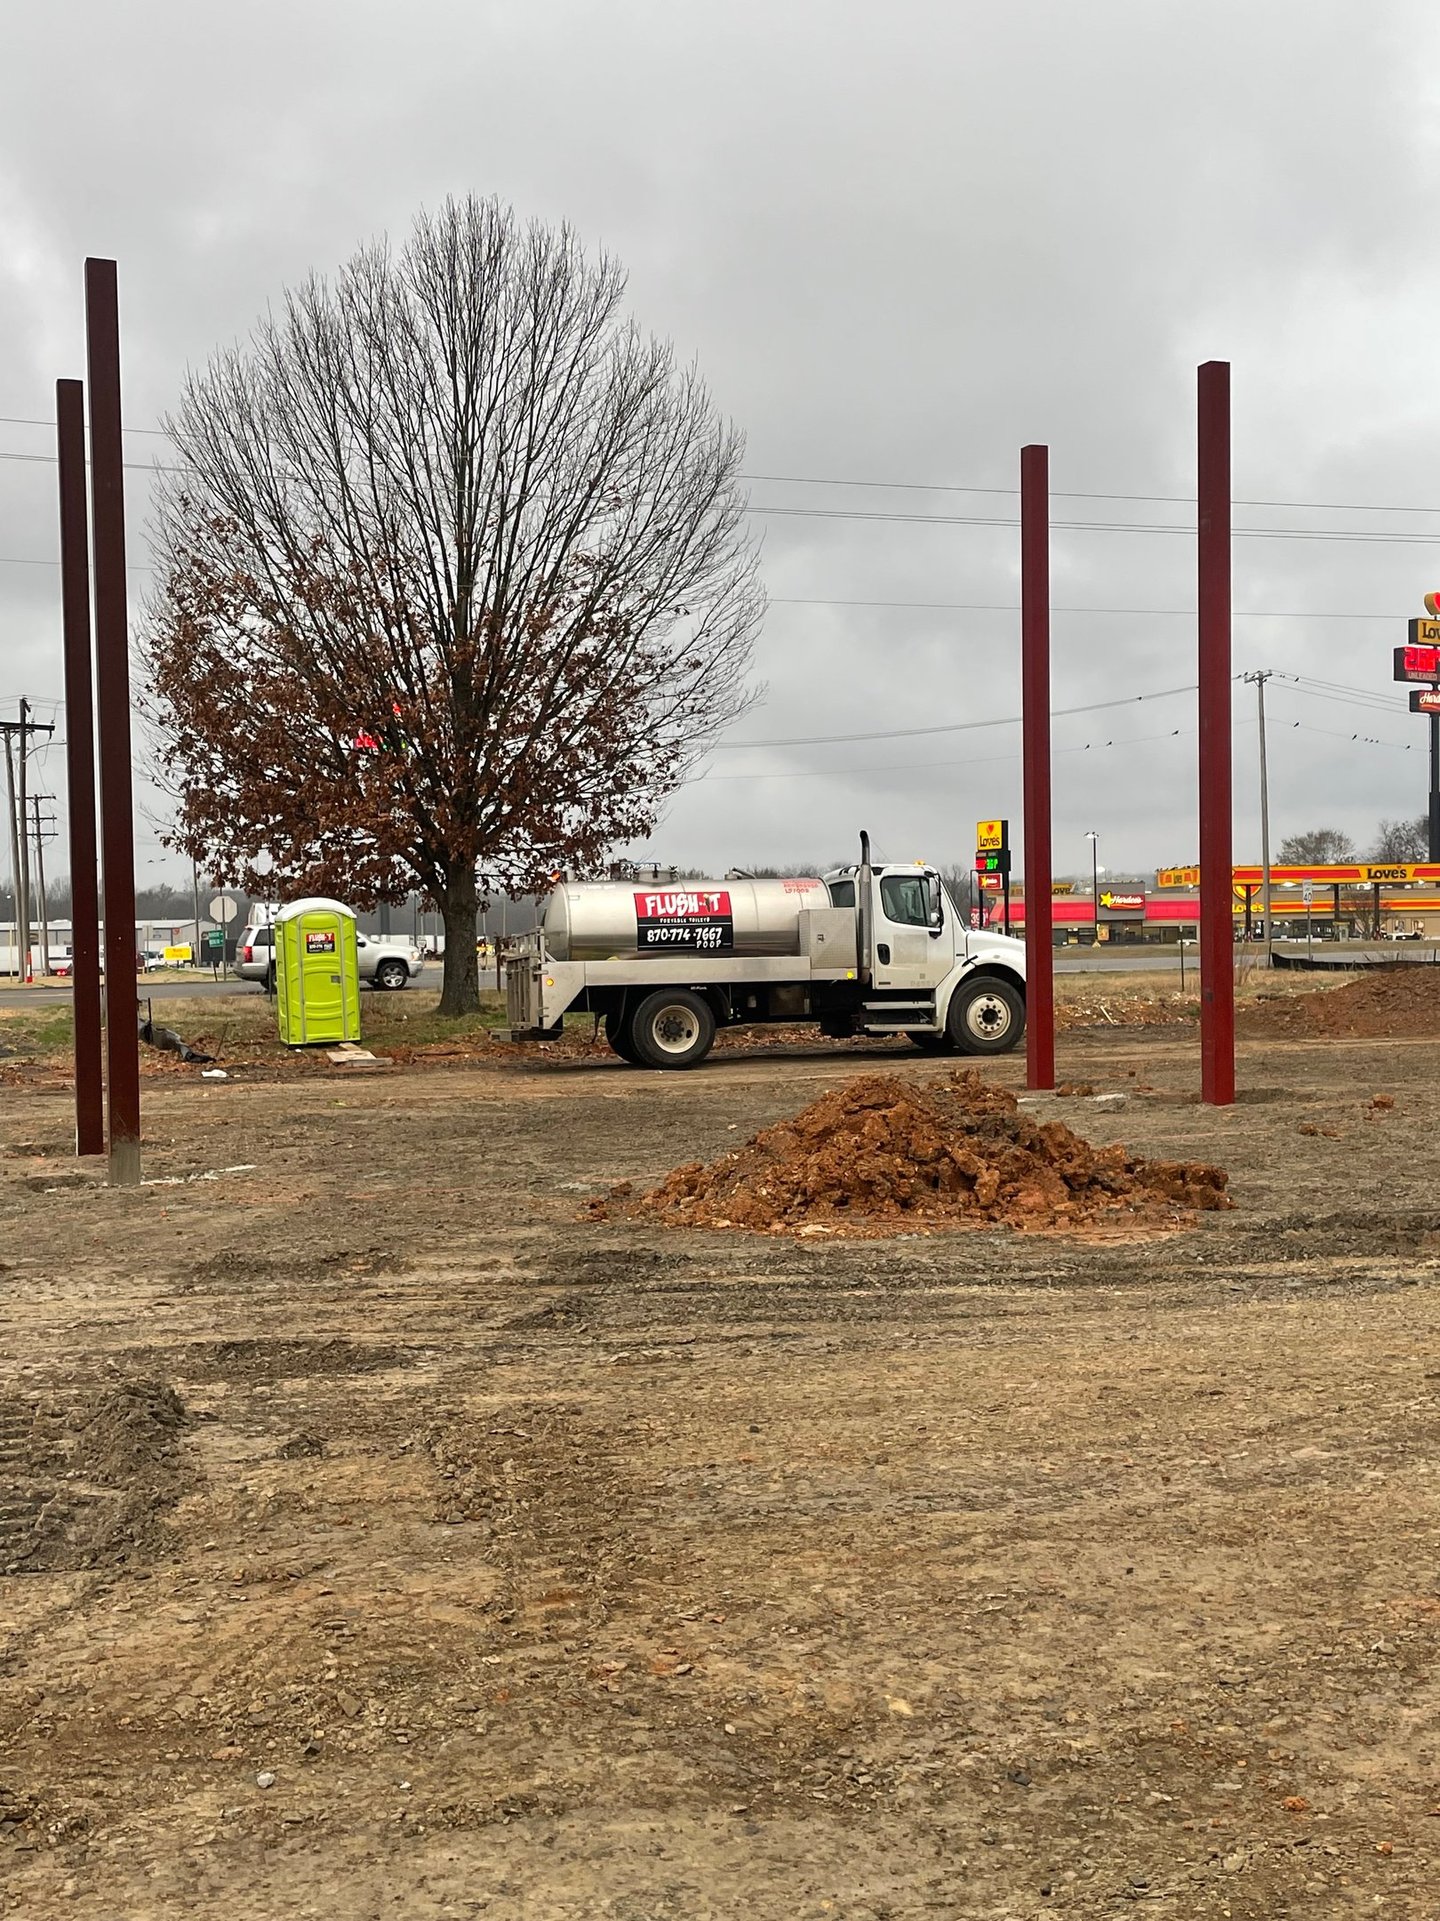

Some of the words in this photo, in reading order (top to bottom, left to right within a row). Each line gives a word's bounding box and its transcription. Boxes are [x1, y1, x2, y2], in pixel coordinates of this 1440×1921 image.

[1367, 866, 1407, 879] Love's
[1303, 892, 1312, 902] 40
[1232, 902, 1265, 913] Loe's
[696, 940, 722, 949] POOP
